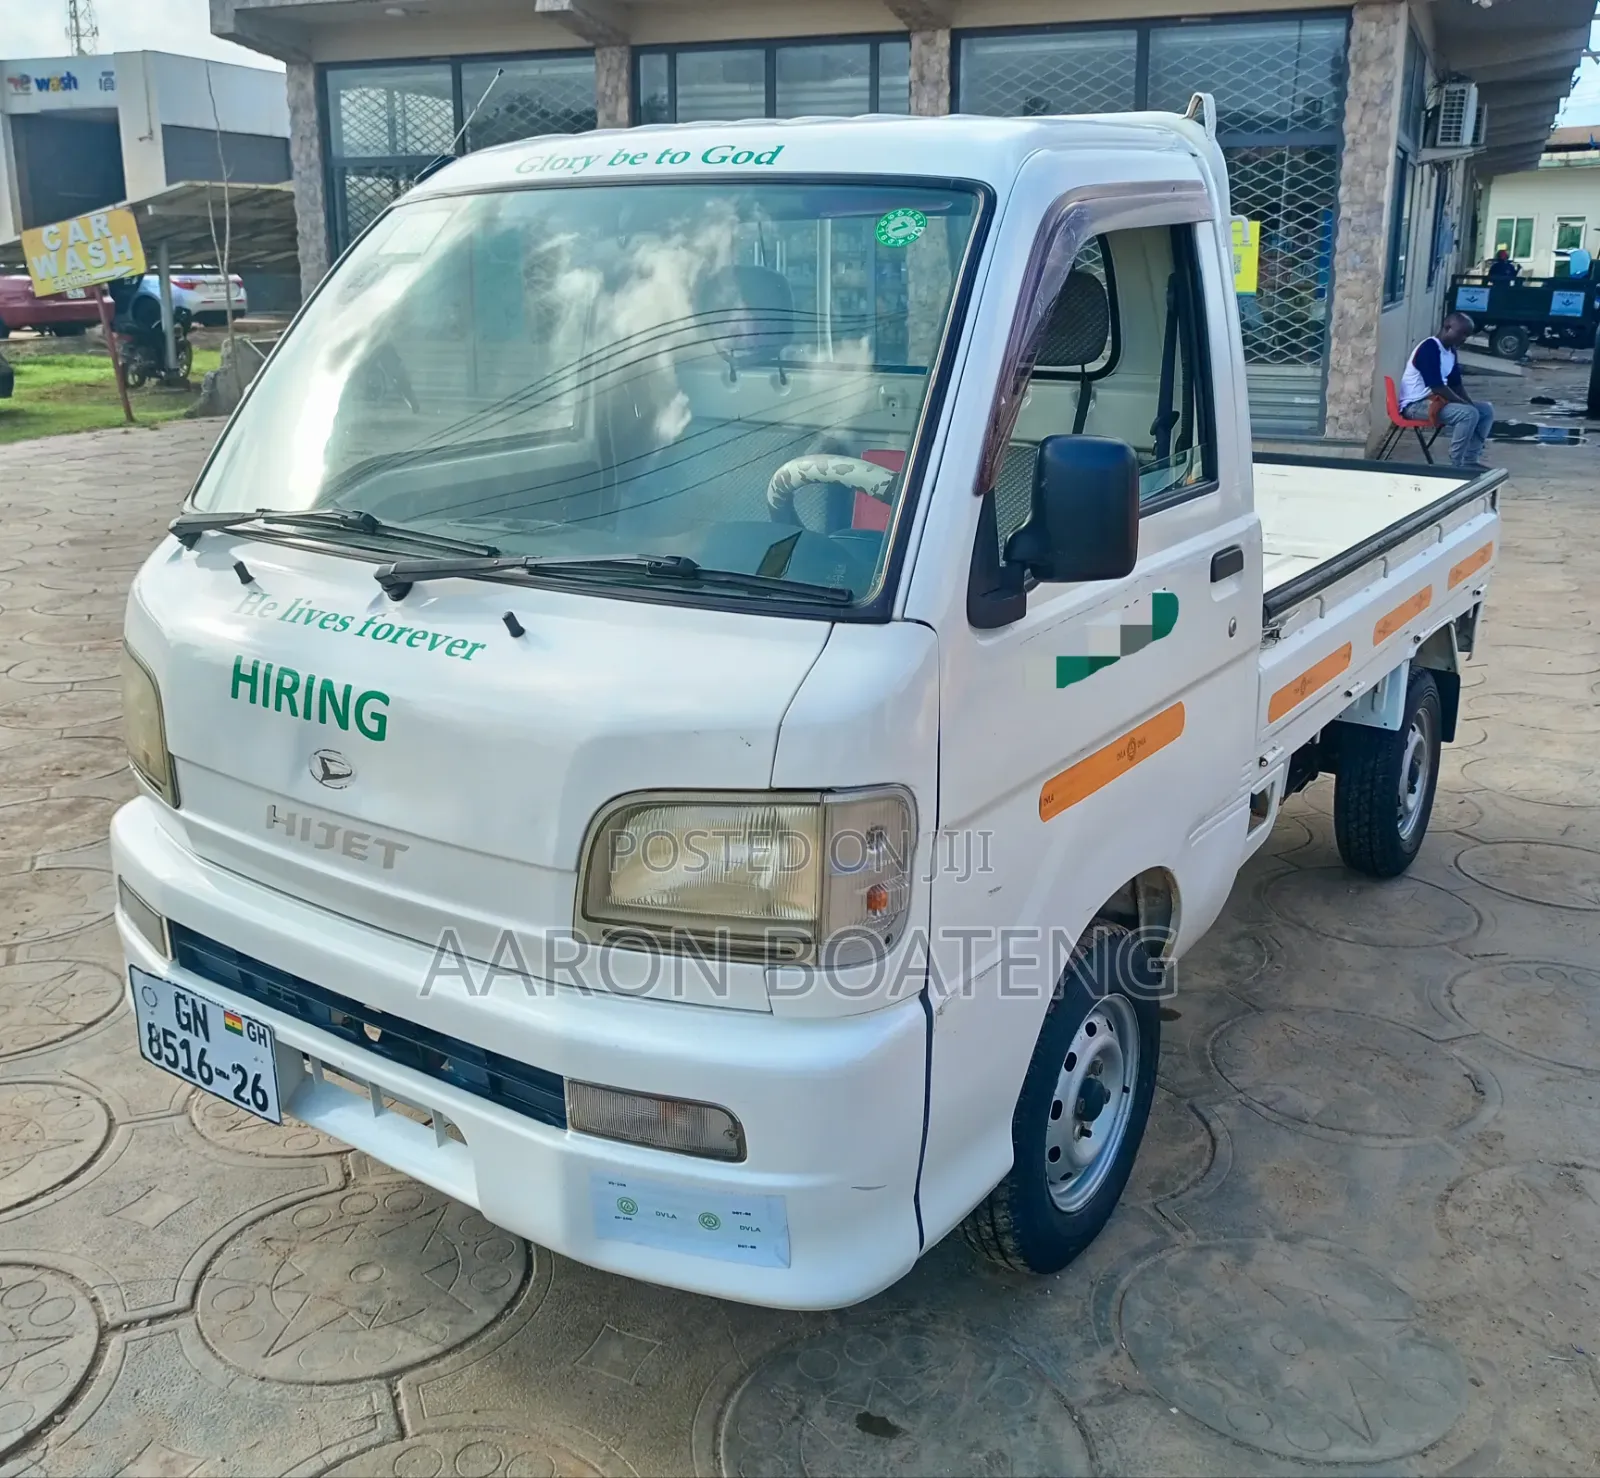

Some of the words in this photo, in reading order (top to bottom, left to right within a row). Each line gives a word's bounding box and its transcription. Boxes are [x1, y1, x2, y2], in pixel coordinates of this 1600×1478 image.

[515, 152, 602, 175] Glory
[607, 148, 648, 167] be
[655, 148, 691, 165] to
[701, 145, 785, 166] God
[32, 235, 133, 281] WASH
[42, 213, 112, 252] CAR
[231, 590, 278, 618] He
[277, 598, 354, 632] lives
[354, 613, 487, 661] forever
[231, 655, 390, 742] HIRING
[266, 804, 410, 869] HIJET
[174, 991, 210, 1043] GN
[247, 1021, 268, 1048] GH
[148, 1021, 269, 1112] 8516-26
[655, 1211, 677, 1220] DVLA
[739, 1225, 761, 1233] DVLA
